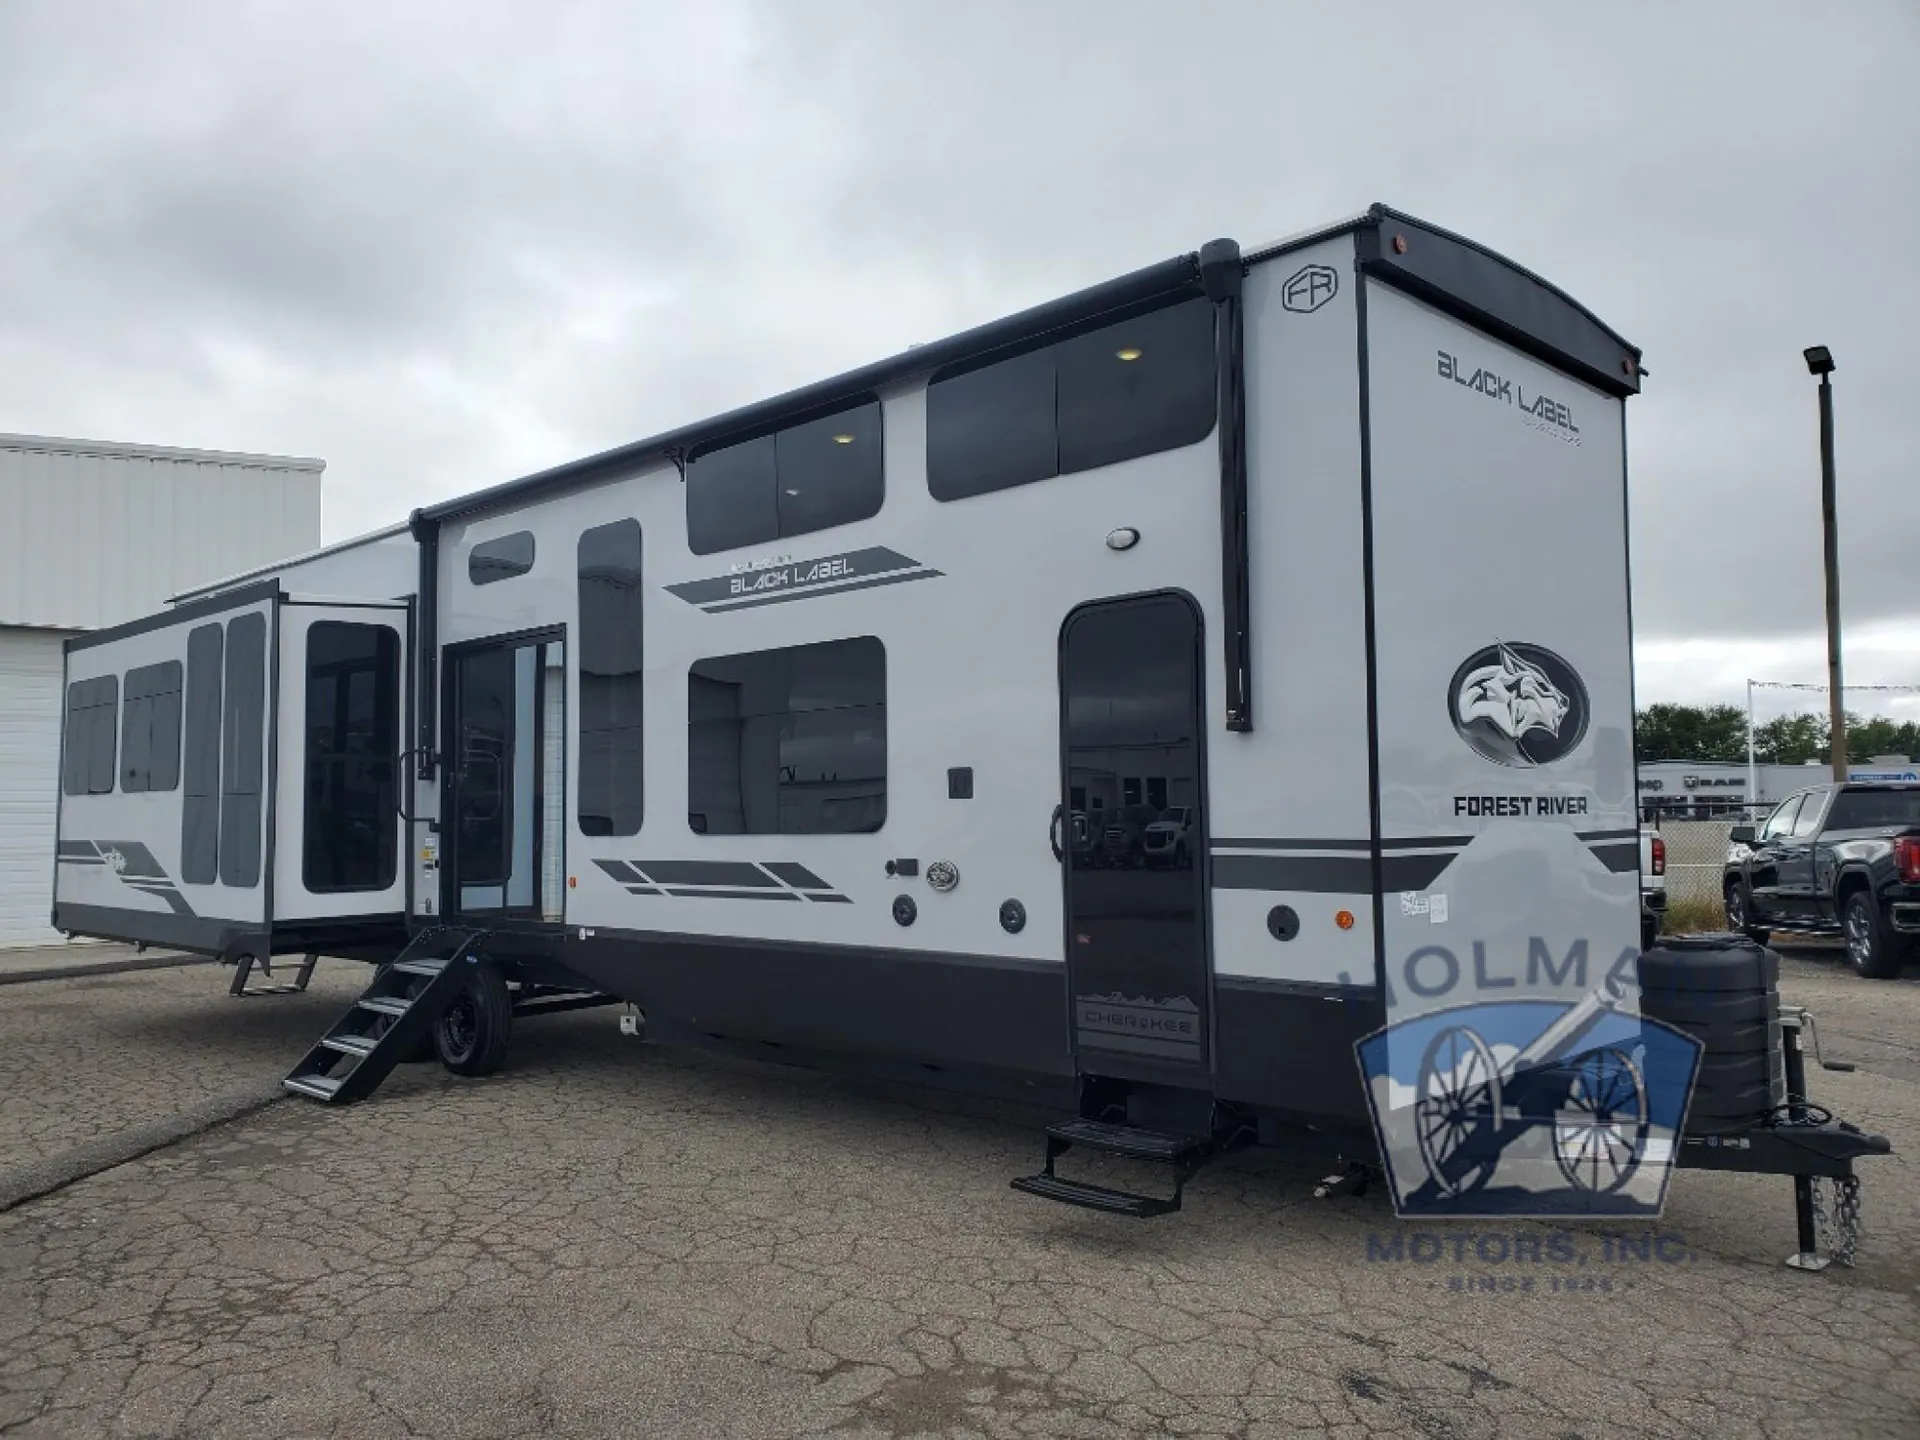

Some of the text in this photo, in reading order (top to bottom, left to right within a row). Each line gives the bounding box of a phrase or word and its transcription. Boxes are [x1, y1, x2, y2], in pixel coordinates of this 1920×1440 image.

[1437, 350, 1512, 405] BLACK
[1518, 385, 1580, 433] LABEL
[730, 570, 789, 594] BLACK
[794, 558, 854, 583] LABEL
[1453, 796, 1588, 816] FOREST RIVER
[1085, 1012, 1193, 1034] CHEROKEE
